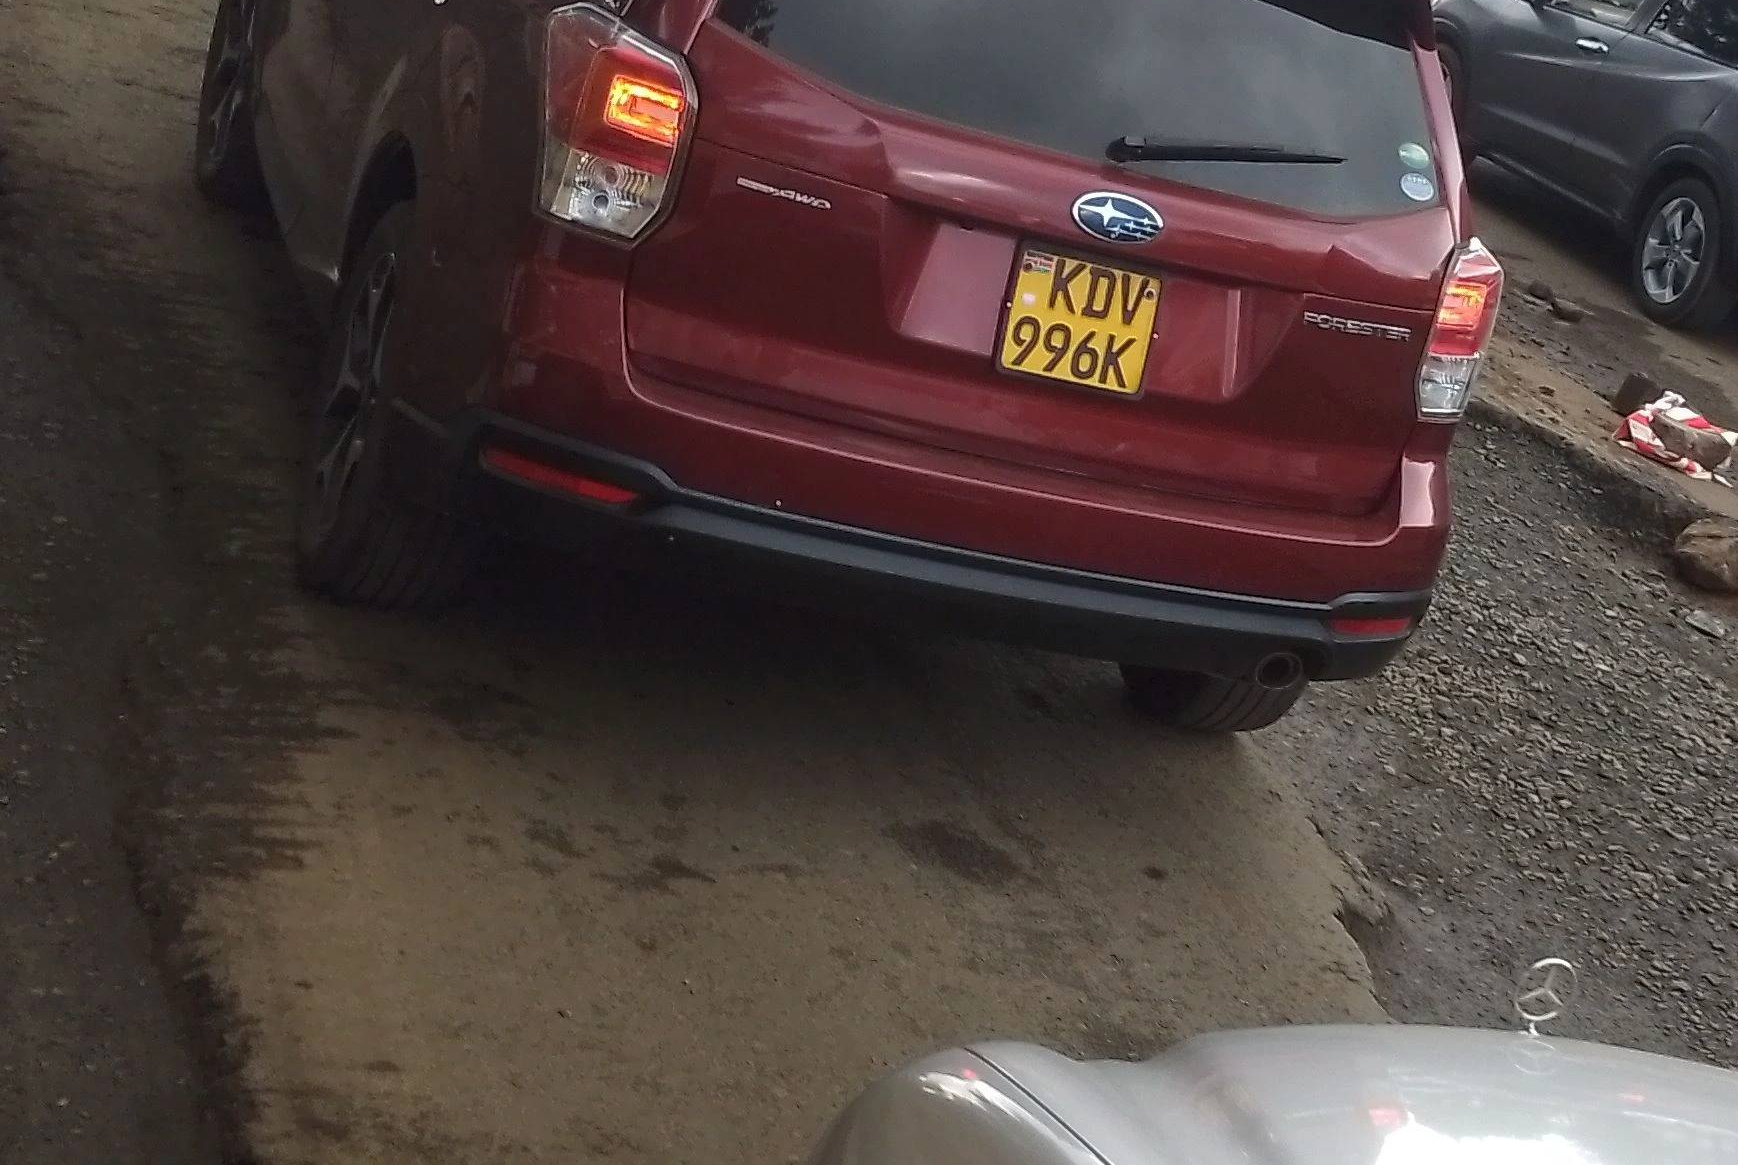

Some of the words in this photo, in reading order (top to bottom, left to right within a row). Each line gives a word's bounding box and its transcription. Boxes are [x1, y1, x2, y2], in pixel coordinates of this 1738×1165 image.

[1049, 258, 1149, 326] KDV
[1011, 316, 1137, 389] 996K
[1304, 311, 1411, 342] FORESTER
